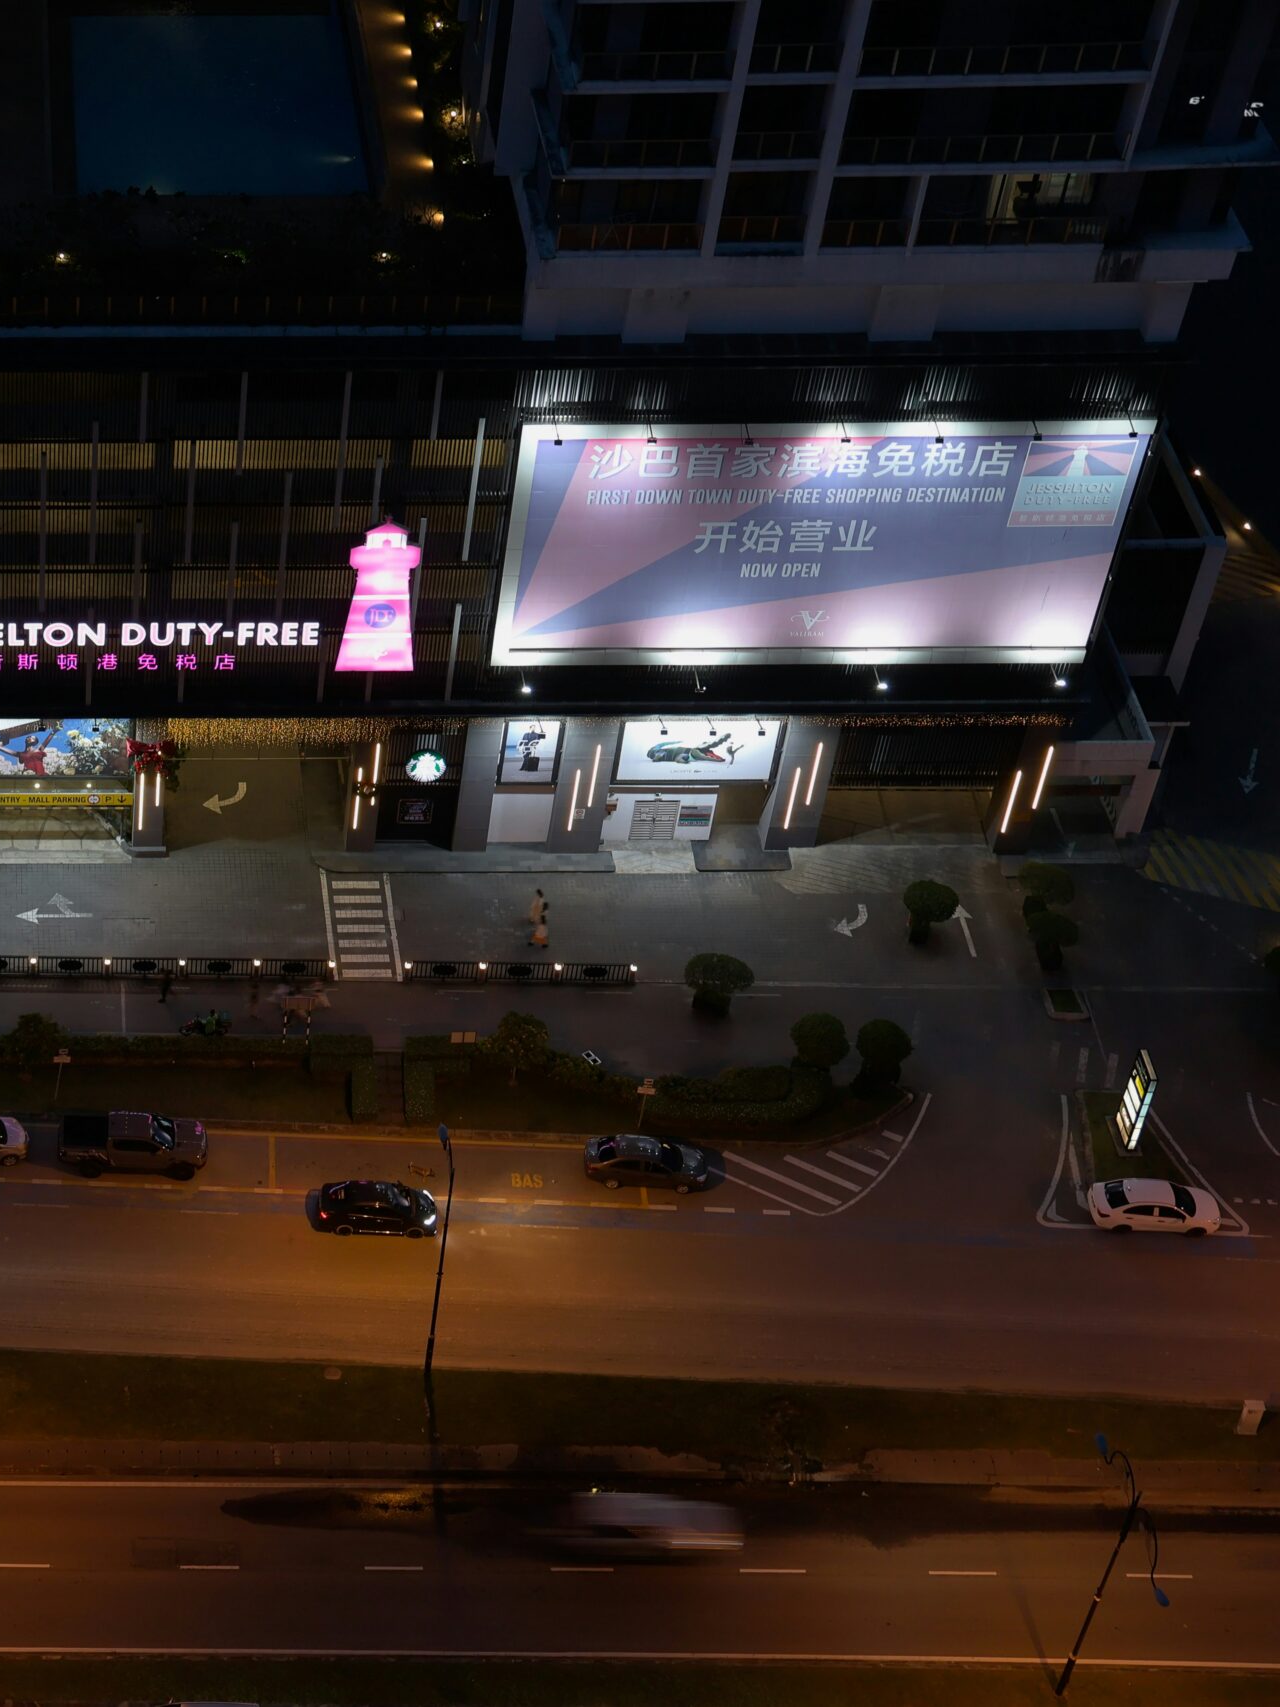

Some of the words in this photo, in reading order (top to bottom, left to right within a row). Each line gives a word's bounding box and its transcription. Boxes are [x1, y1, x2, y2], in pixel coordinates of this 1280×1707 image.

[588, 441, 1017, 480] 沙巴首家滨海免税店
[586, 489, 631, 506] FIRST
[635, 489, 683, 505] DOWN
[687, 489, 733, 505] TOWN
[736, 488, 821, 505] DUTY-FREE
[825, 488, 903, 504] SHOPPING
[906, 487, 1006, 503] DESTINATION
[1026, 482, 1113, 495] JESSELTON
[1023, 496, 1111, 506] DUTY-FREE
[694, 520, 878, 554] 开始营业
[740, 562, 778, 579] NOW
[781, 562, 821, 578] OPEN
[121, 621, 320, 647] DUTY-FREE
[511, 1173, 544, 1189] BAS
